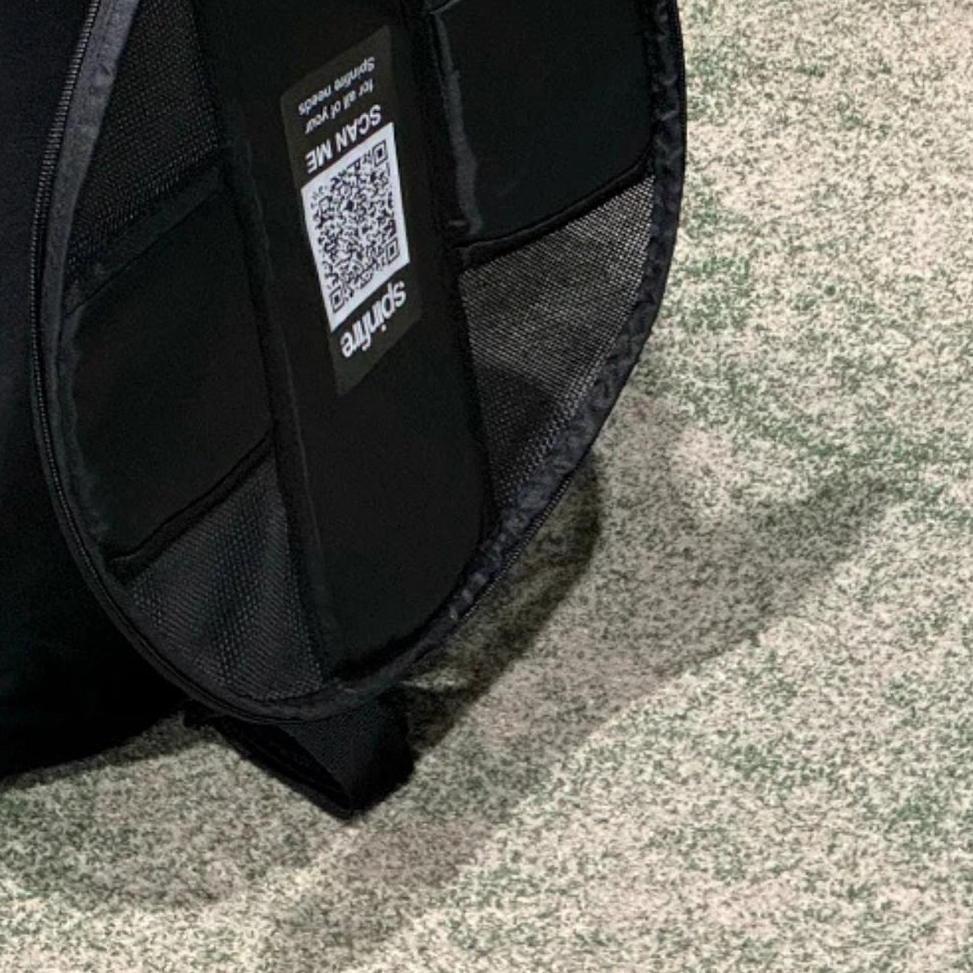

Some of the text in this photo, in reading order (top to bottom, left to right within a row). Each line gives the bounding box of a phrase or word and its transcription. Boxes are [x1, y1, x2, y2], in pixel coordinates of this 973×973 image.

[304, 104, 382, 174] SCAN ME
[340, 281, 407, 358] spinfire
